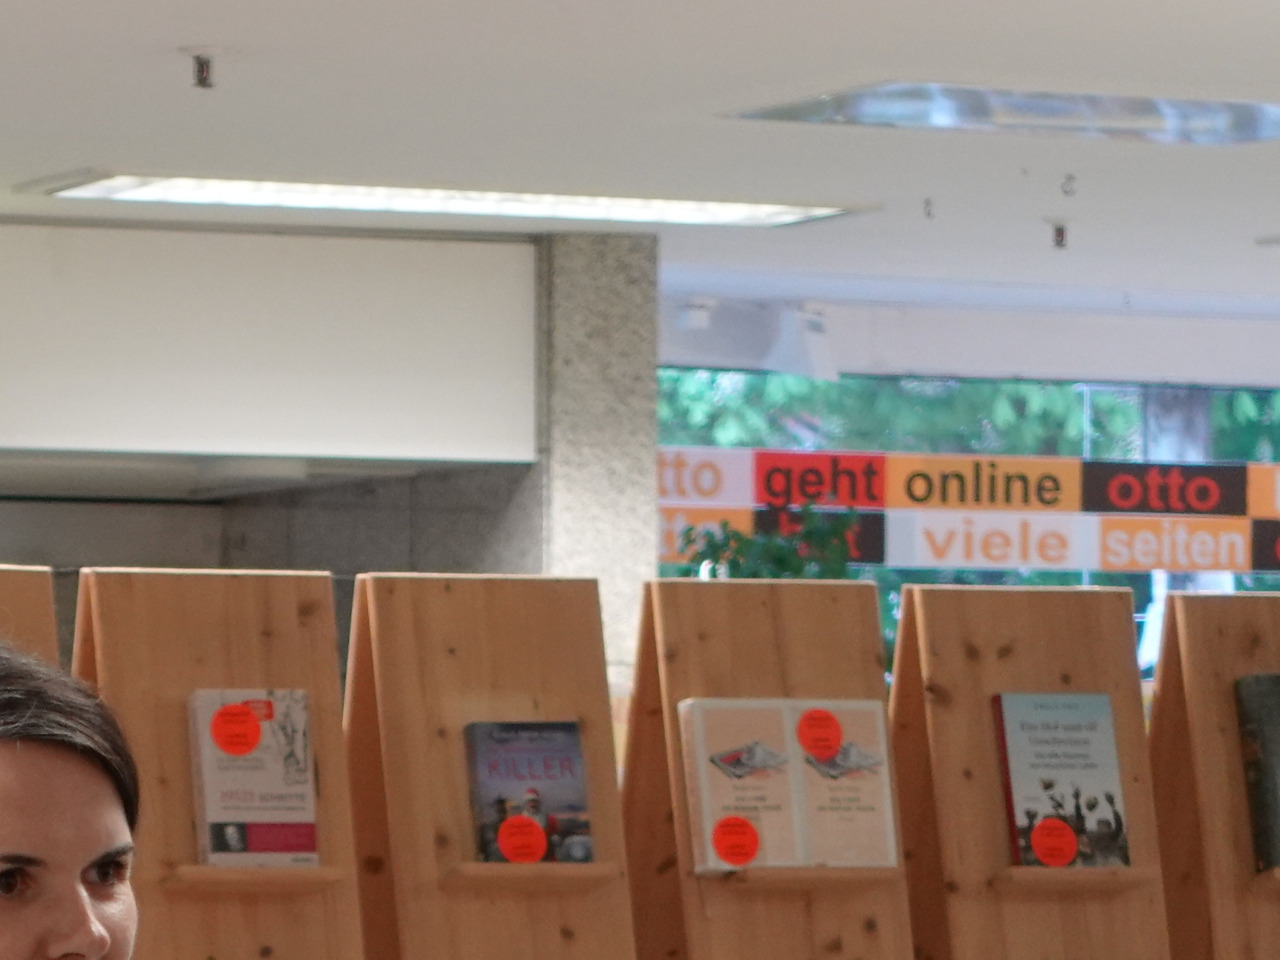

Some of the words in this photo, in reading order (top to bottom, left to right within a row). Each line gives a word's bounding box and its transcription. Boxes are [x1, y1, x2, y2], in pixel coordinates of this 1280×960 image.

[657, 452, 723, 497] tto
[764, 457, 878, 510] geht
[906, 460, 1061, 505] online
[1107, 467, 1220, 511] otto
[923, 518, 1068, 562] viele
[1106, 520, 1246, 566] seiten
[486, 756, 575, 781] KILLER
